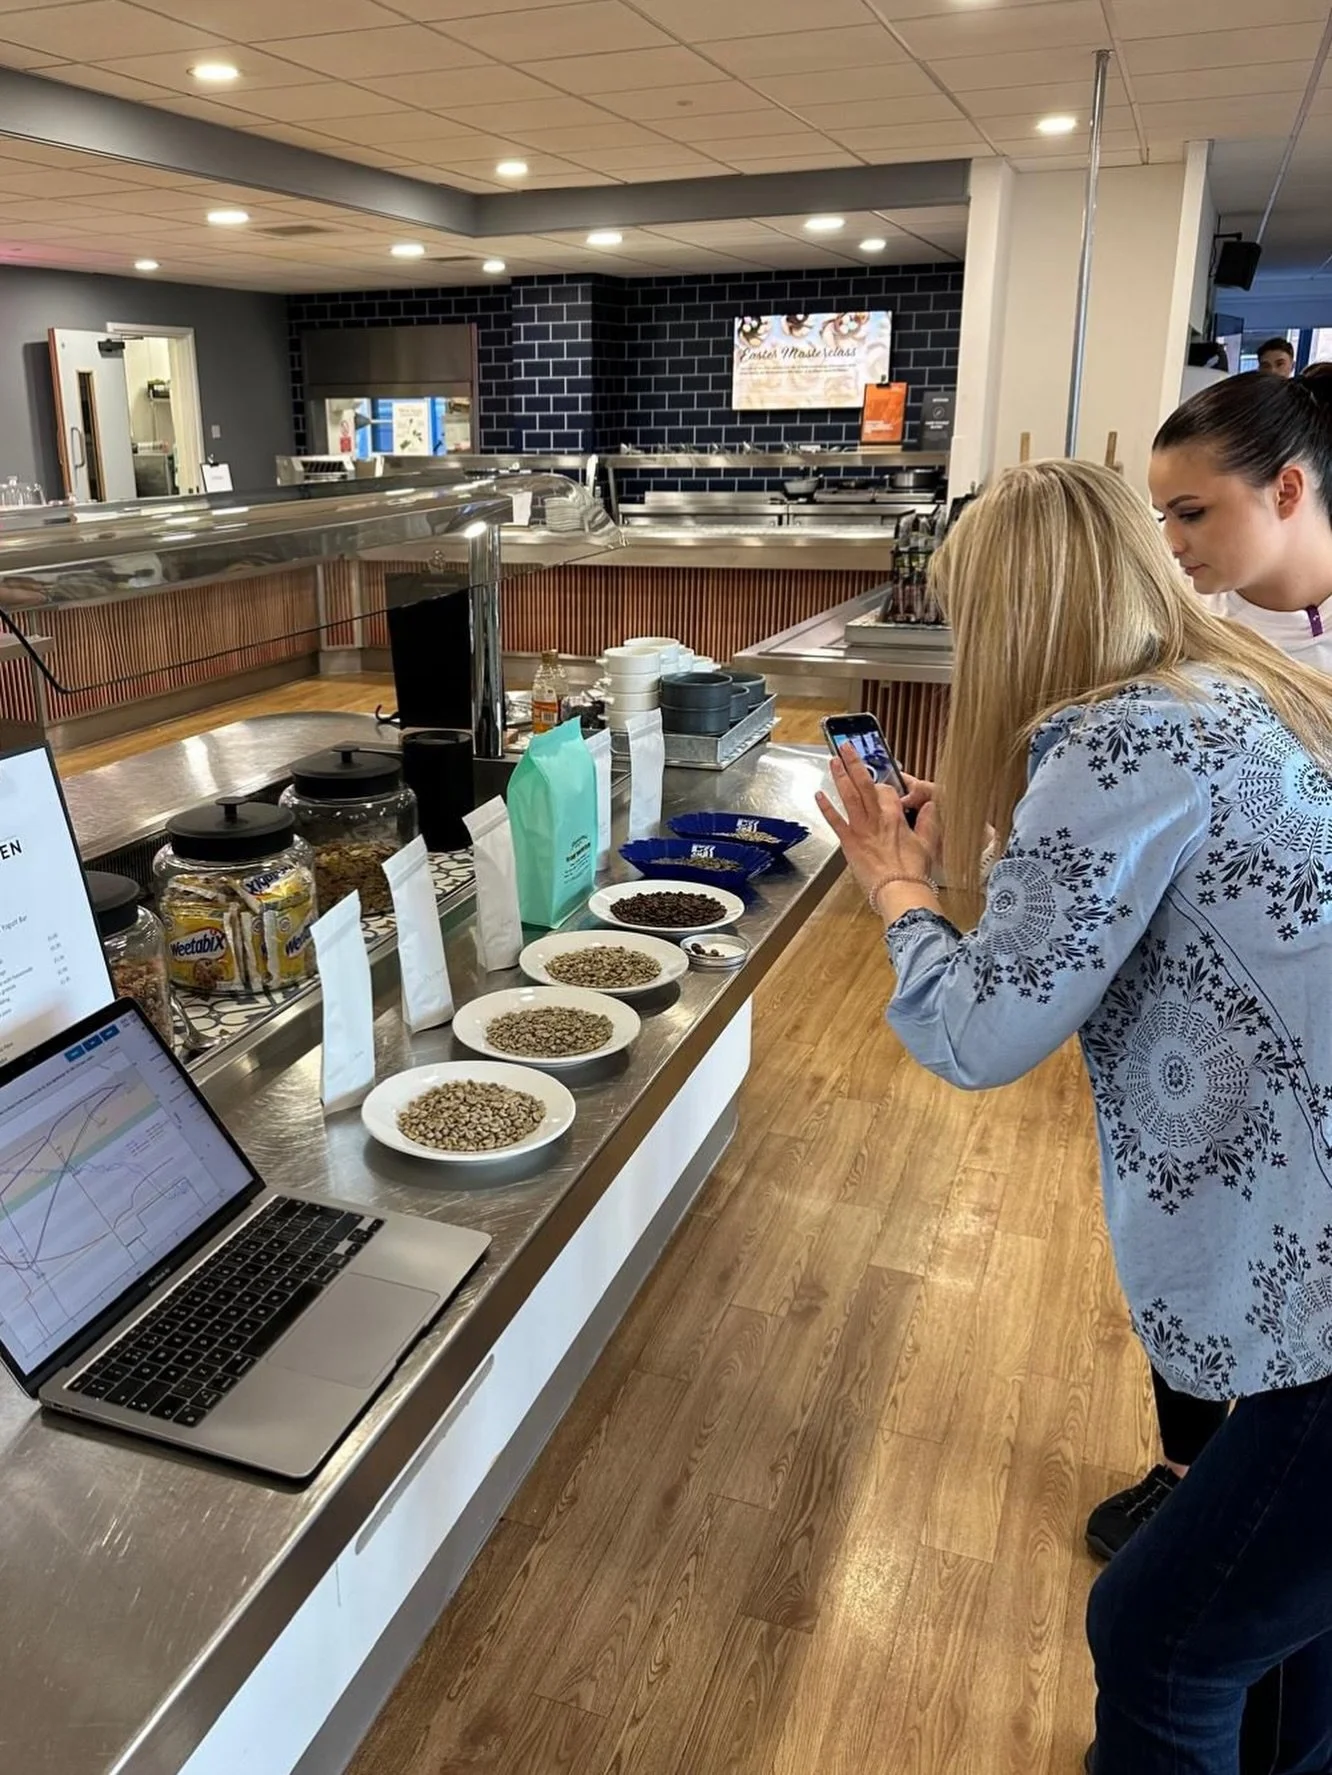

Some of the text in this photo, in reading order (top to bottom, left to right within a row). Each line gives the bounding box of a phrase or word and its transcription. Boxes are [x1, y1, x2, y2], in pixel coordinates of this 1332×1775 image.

[740, 346, 857, 362] Easter Masterclass
[170, 933, 227, 956] Weetabix
